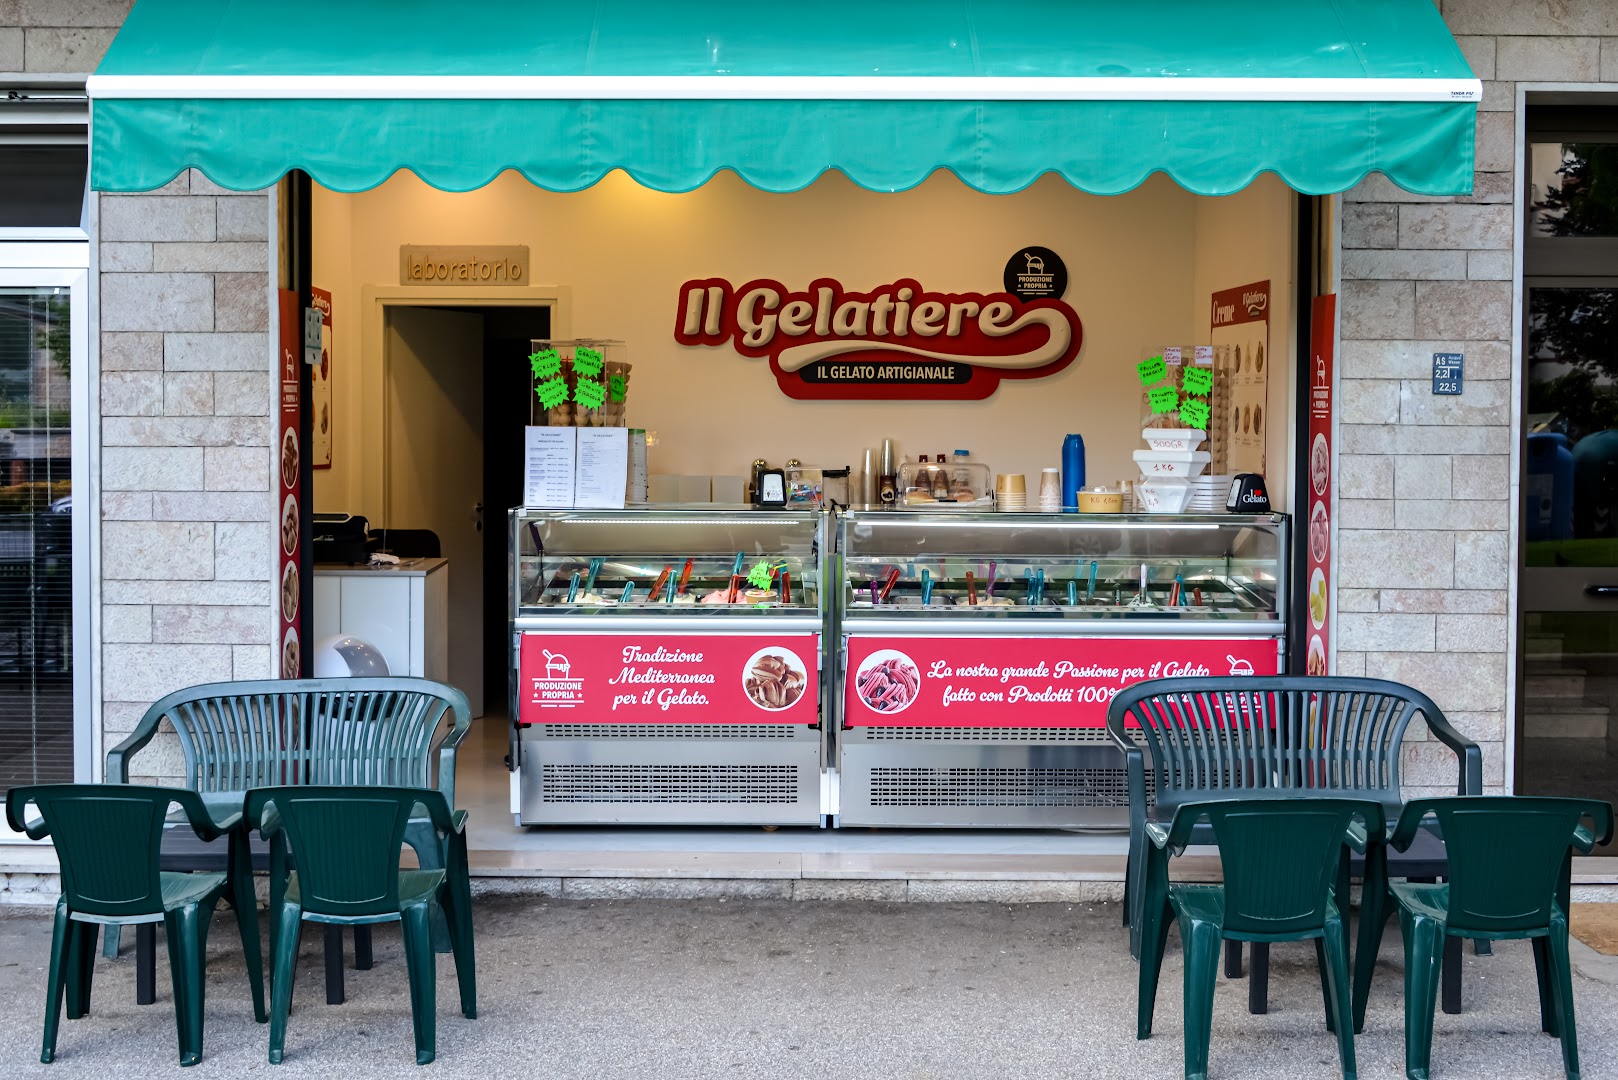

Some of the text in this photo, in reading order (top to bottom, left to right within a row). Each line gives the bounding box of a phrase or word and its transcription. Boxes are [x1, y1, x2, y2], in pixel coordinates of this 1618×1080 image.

[407, 254, 522, 281] laboratorio
[683, 286, 1022, 348] Il Gelatiere
[1212, 300, 1235, 325] Creme
[1435, 356, 1446, 366] AS
[817, 365, 955, 380] IL GELATO ARTIGIANALE
[1435, 369, 1448, 379] 2,2
[1439, 382, 1457, 393] 22,5
[1153, 439, 1183, 449] 500GR
[1162, 463, 1174, 472] KG
[1090, 496, 1100, 504] KG
[1242, 494, 1267, 504] Gelato
[622, 645, 704, 664] Tradizione
[608, 667, 715, 686] Mediterranea
[927, 660, 1210, 684] La nostra grande Passione per il Gelato
[534, 682, 582, 691] PRODUZIONE
[542, 691, 575, 700] PROPRIA
[611, 688, 710, 711] per il Gelato.
[943, 685, 976, 707] fatto
[979, 691, 1004, 703] con
[1007, 685, 1073, 704] Prodotti
